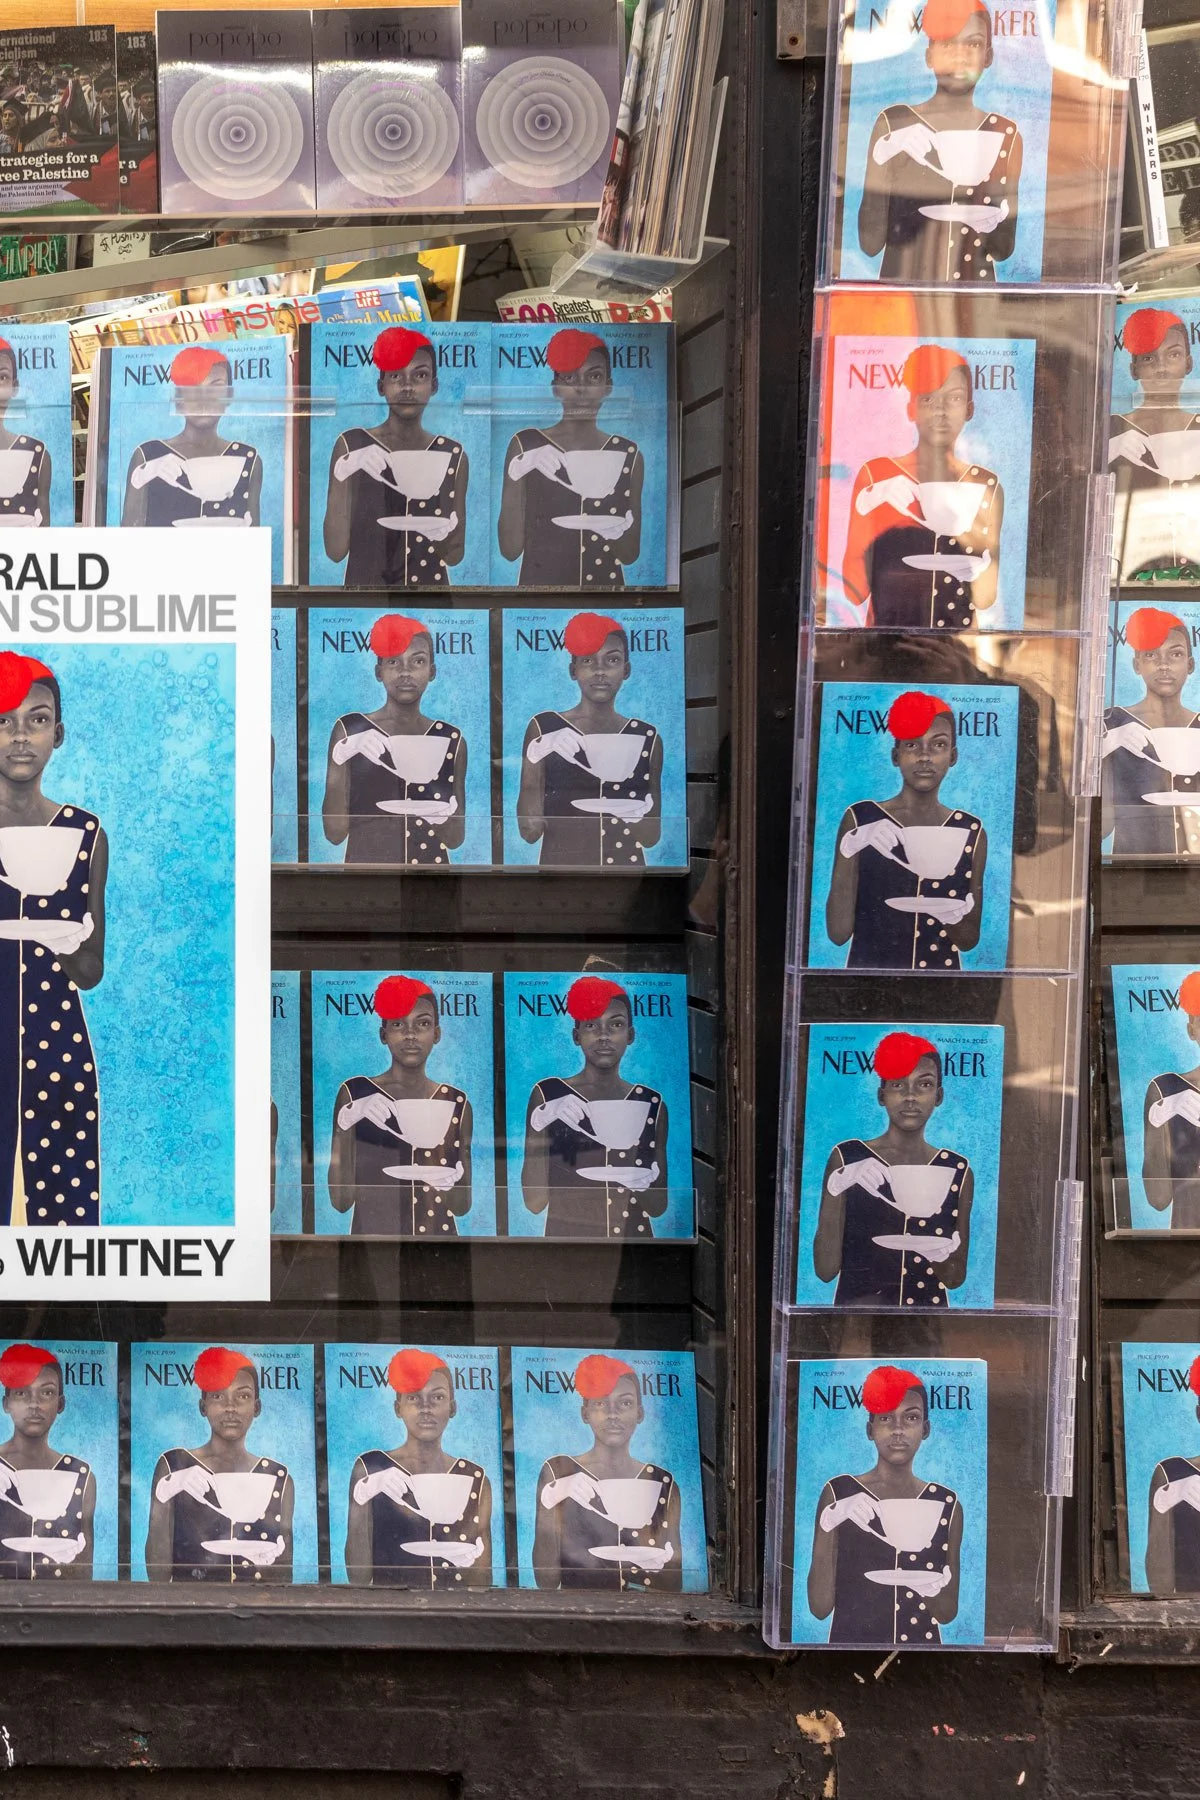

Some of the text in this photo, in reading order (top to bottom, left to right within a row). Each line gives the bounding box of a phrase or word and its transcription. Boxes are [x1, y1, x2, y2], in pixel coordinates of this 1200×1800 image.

[993, 10, 1038, 37] KER
[89, 30, 108, 43] 183
[127, 36, 146, 49] 183
[1142, 102, 1158, 180] WINNERS
[66, 153, 87, 164] for
[89, 156, 99, 164] a
[22, 166, 90, 181] Palestine
[355, 289, 381, 308] LIFE
[553, 300, 593, 314] Greatest
[222, 296, 320, 333] InStle
[18, 346, 58, 371] KER
[324, 344, 479, 369] NEW KER
[498, 345, 653, 370] NEW KER
[124, 358, 273, 387] NEW KER
[848, 364, 1017, 391] NEW KER
[29, 594, 237, 633] SUBLIME
[321, 630, 476, 655] NEW KER
[516, 628, 671, 653] NEW KER
[835, 710, 1001, 737] NEW KER
[325, 992, 480, 1017] NEW KER
[517, 993, 674, 1018] NEW KER
[1128, 989, 1180, 1013] NEW
[822, 1050, 988, 1078] NEW KER
[16, 1238, 236, 1277] WHITNEY
[65, 1362, 106, 1387] KER
[145, 1363, 301, 1390] NEW KER
[339, 1365, 496, 1391] NEW KER
[526, 1370, 682, 1397] NEW KER
[1137, 1368, 1190, 1393] NEW
[813, 1385, 973, 1411] NEW KER
